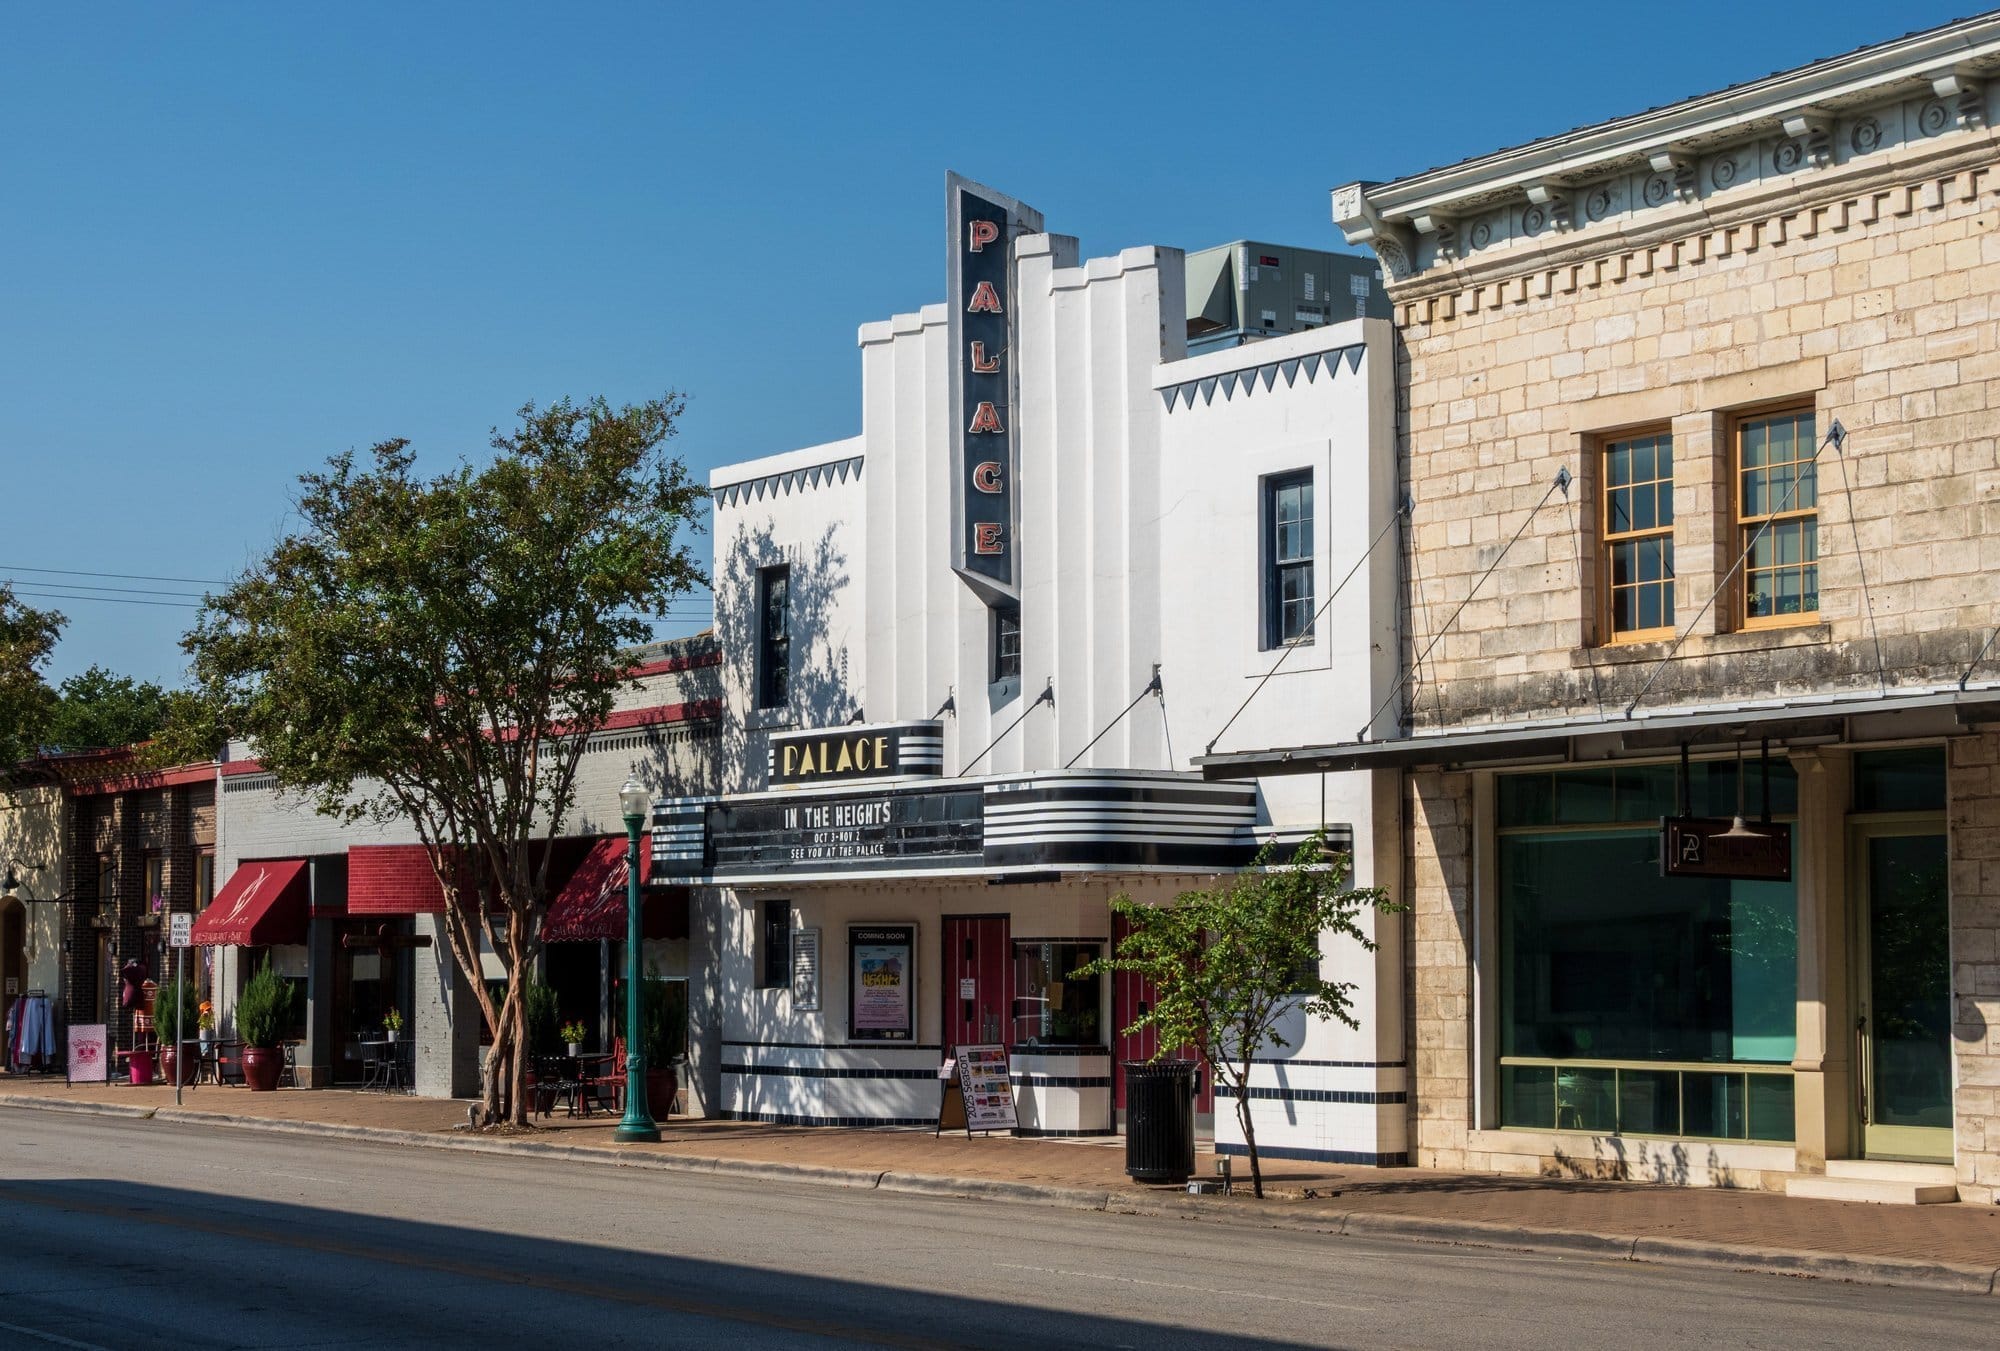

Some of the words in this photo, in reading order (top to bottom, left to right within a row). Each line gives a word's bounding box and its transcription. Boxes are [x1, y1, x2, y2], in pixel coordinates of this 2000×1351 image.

[969, 220, 1004, 555] PALACE
[783, 737, 888, 776] PALACE
[785, 809, 798, 829] IN
[805, 806, 830, 827] THE
[835, 802, 890, 826] HEIGHTS
[814, 832, 829, 844] OCT
[831, 831, 853, 843] 3-NOV
[856, 831, 861, 842] 2
[790, 848, 805, 860] SEE
[808, 847, 823, 858] YOU
[826, 846, 837, 857] AT
[839, 846, 853, 857] THE
[856, 844, 885, 856] PALACE
[965, 1095, 977, 1119] 2025
